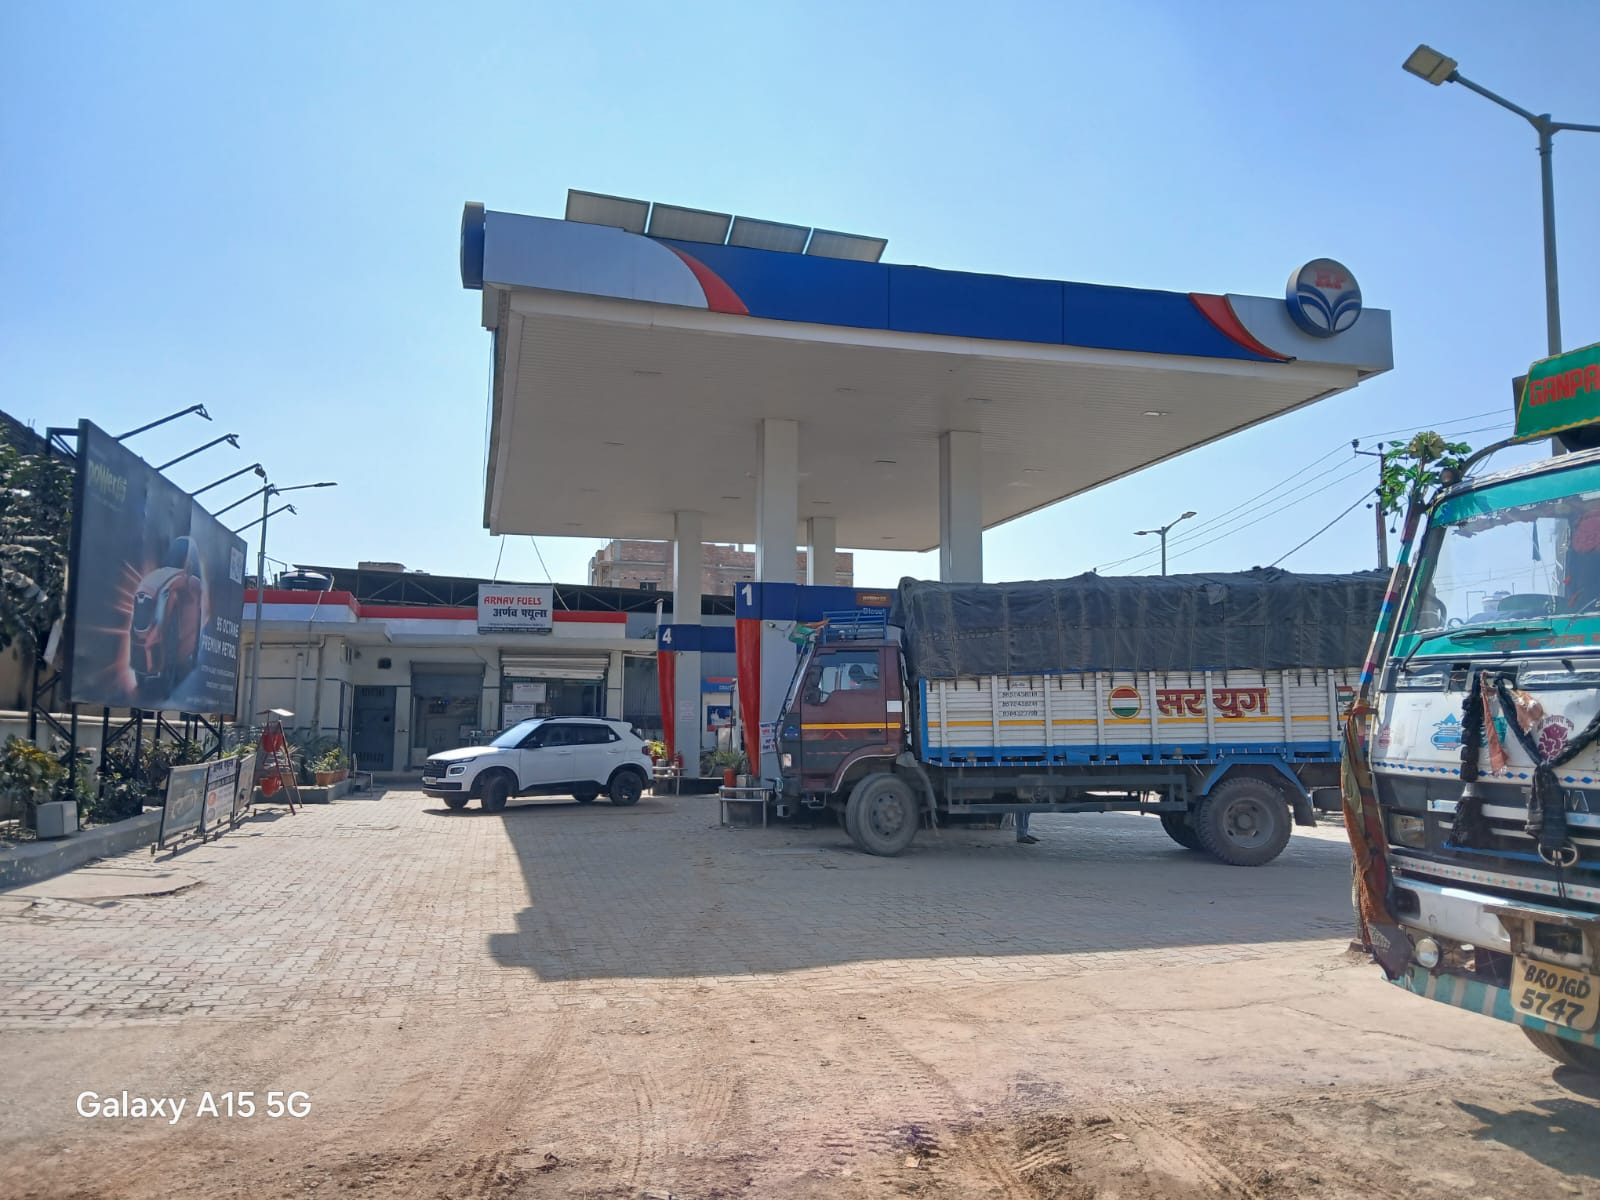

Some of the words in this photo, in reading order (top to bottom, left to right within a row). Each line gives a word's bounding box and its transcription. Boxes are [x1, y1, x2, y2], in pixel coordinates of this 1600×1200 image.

[1529, 363, 1600, 407] GANPA
[484, 596, 515, 606] ARNAV
[517, 596, 543, 606] FUELS
[741, 583, 753, 606] 1
[662, 628, 673, 644] 4
[1523, 965, 1591, 999] BR01GD
[1520, 987, 1584, 1026] 5747
